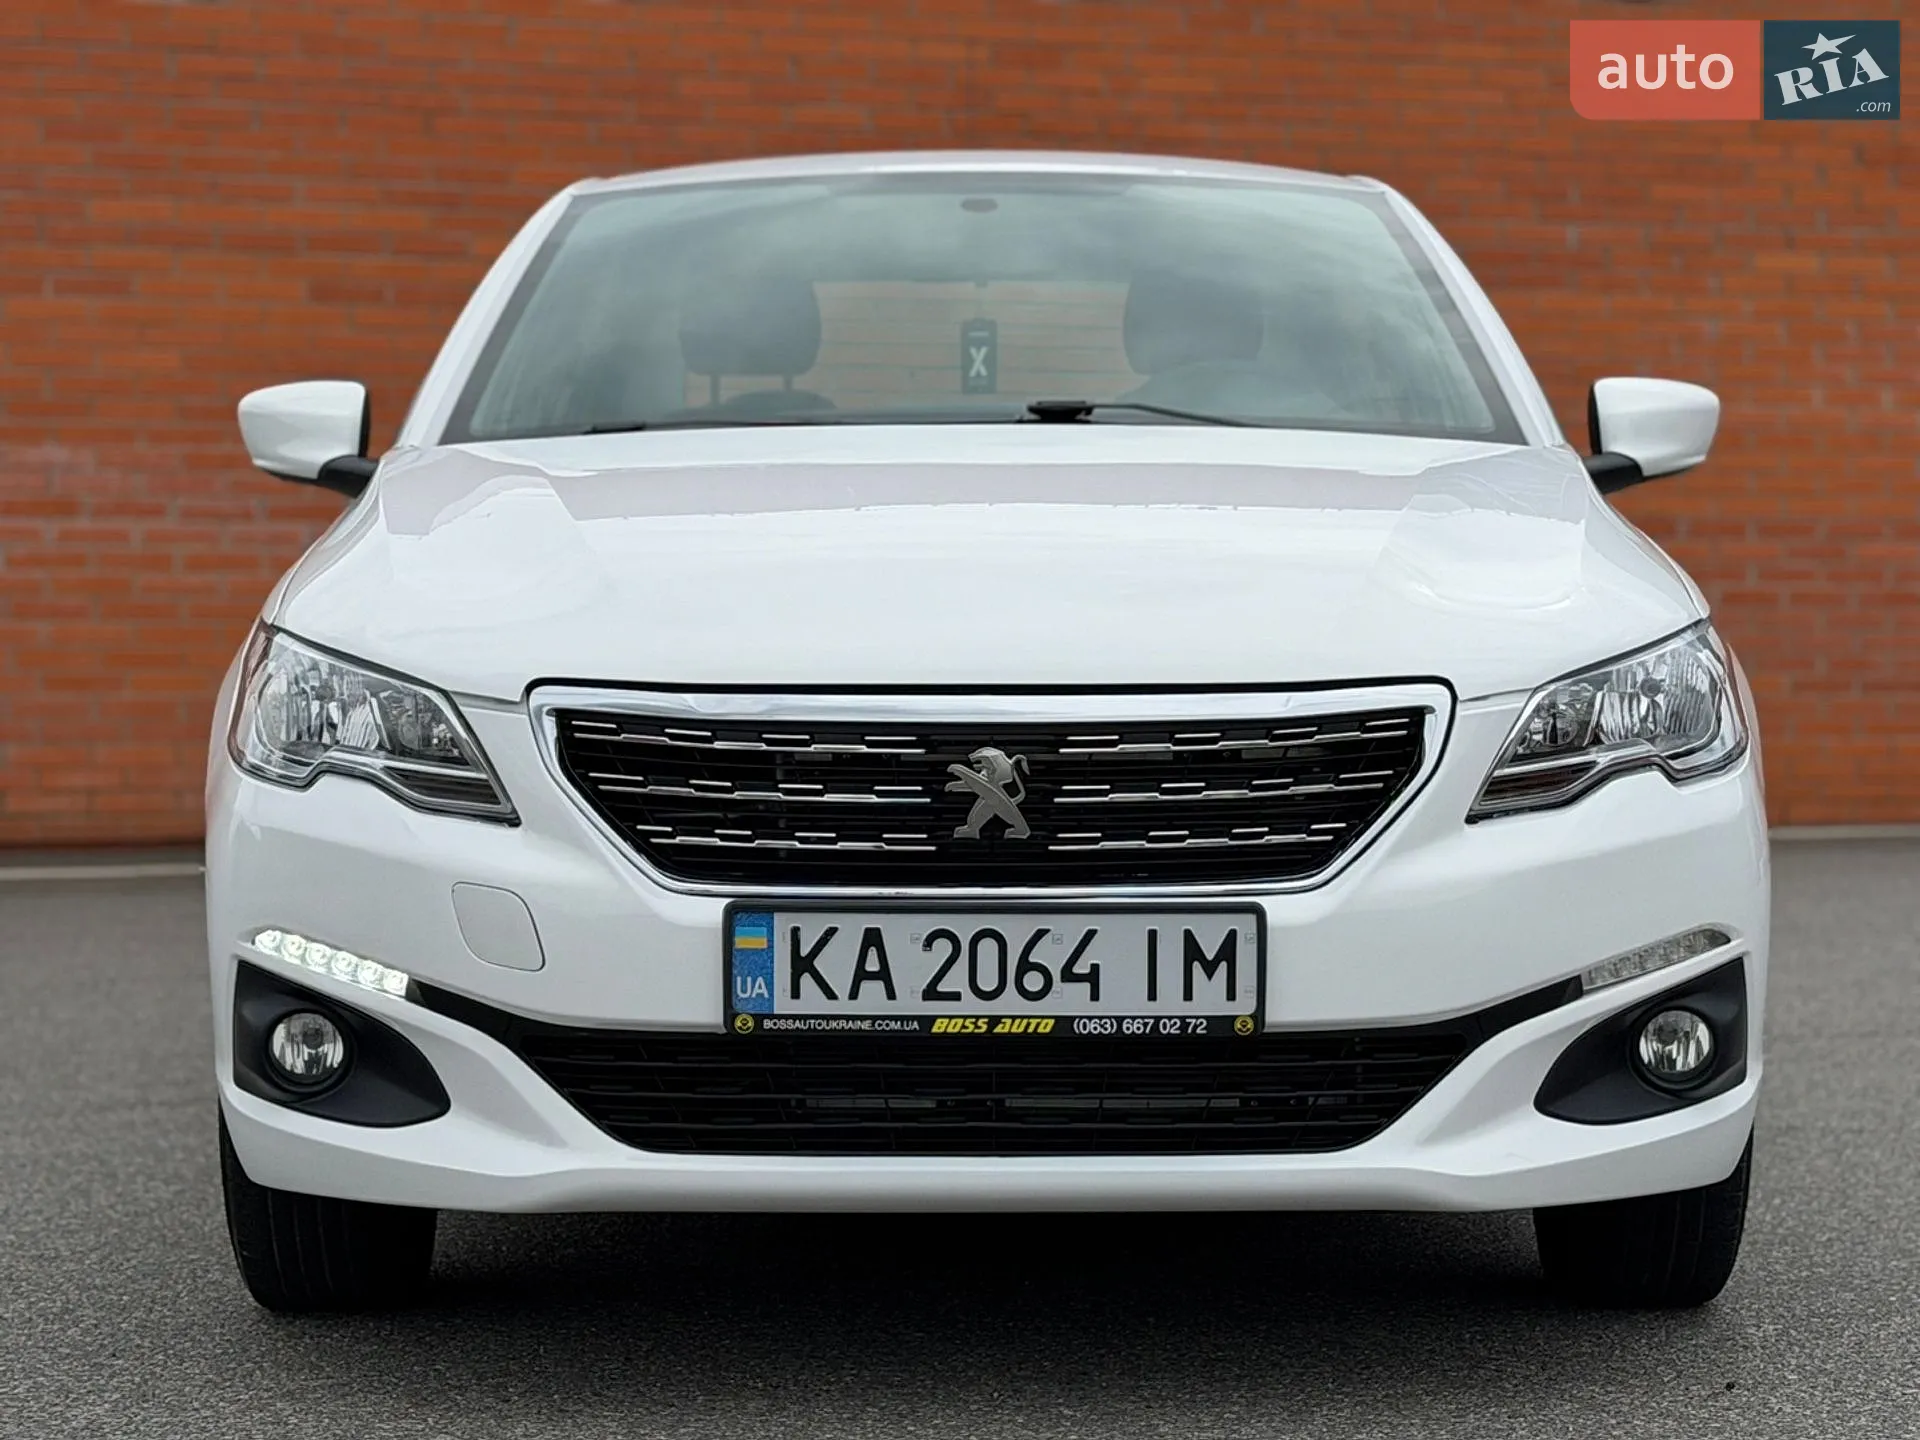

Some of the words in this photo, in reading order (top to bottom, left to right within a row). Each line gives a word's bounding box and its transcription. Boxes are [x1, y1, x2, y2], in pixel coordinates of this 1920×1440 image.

[790, 925, 898, 1001] KA
[921, 927, 1101, 1002] 2064
[1147, 928, 1238, 1002] IM
[735, 977, 770, 999] UA
[762, 1018, 920, 1031] BOSSAUTOUKRAINE.COM.UA
[931, 1018, 989, 1033] BOSS
[992, 1018, 1055, 1033] AUTO
[1073, 1018, 1117, 1034] (063)
[1122, 1018, 1155, 1035] 667
[1159, 1018, 1181, 1035] 02
[1185, 1018, 1208, 1035] 72
